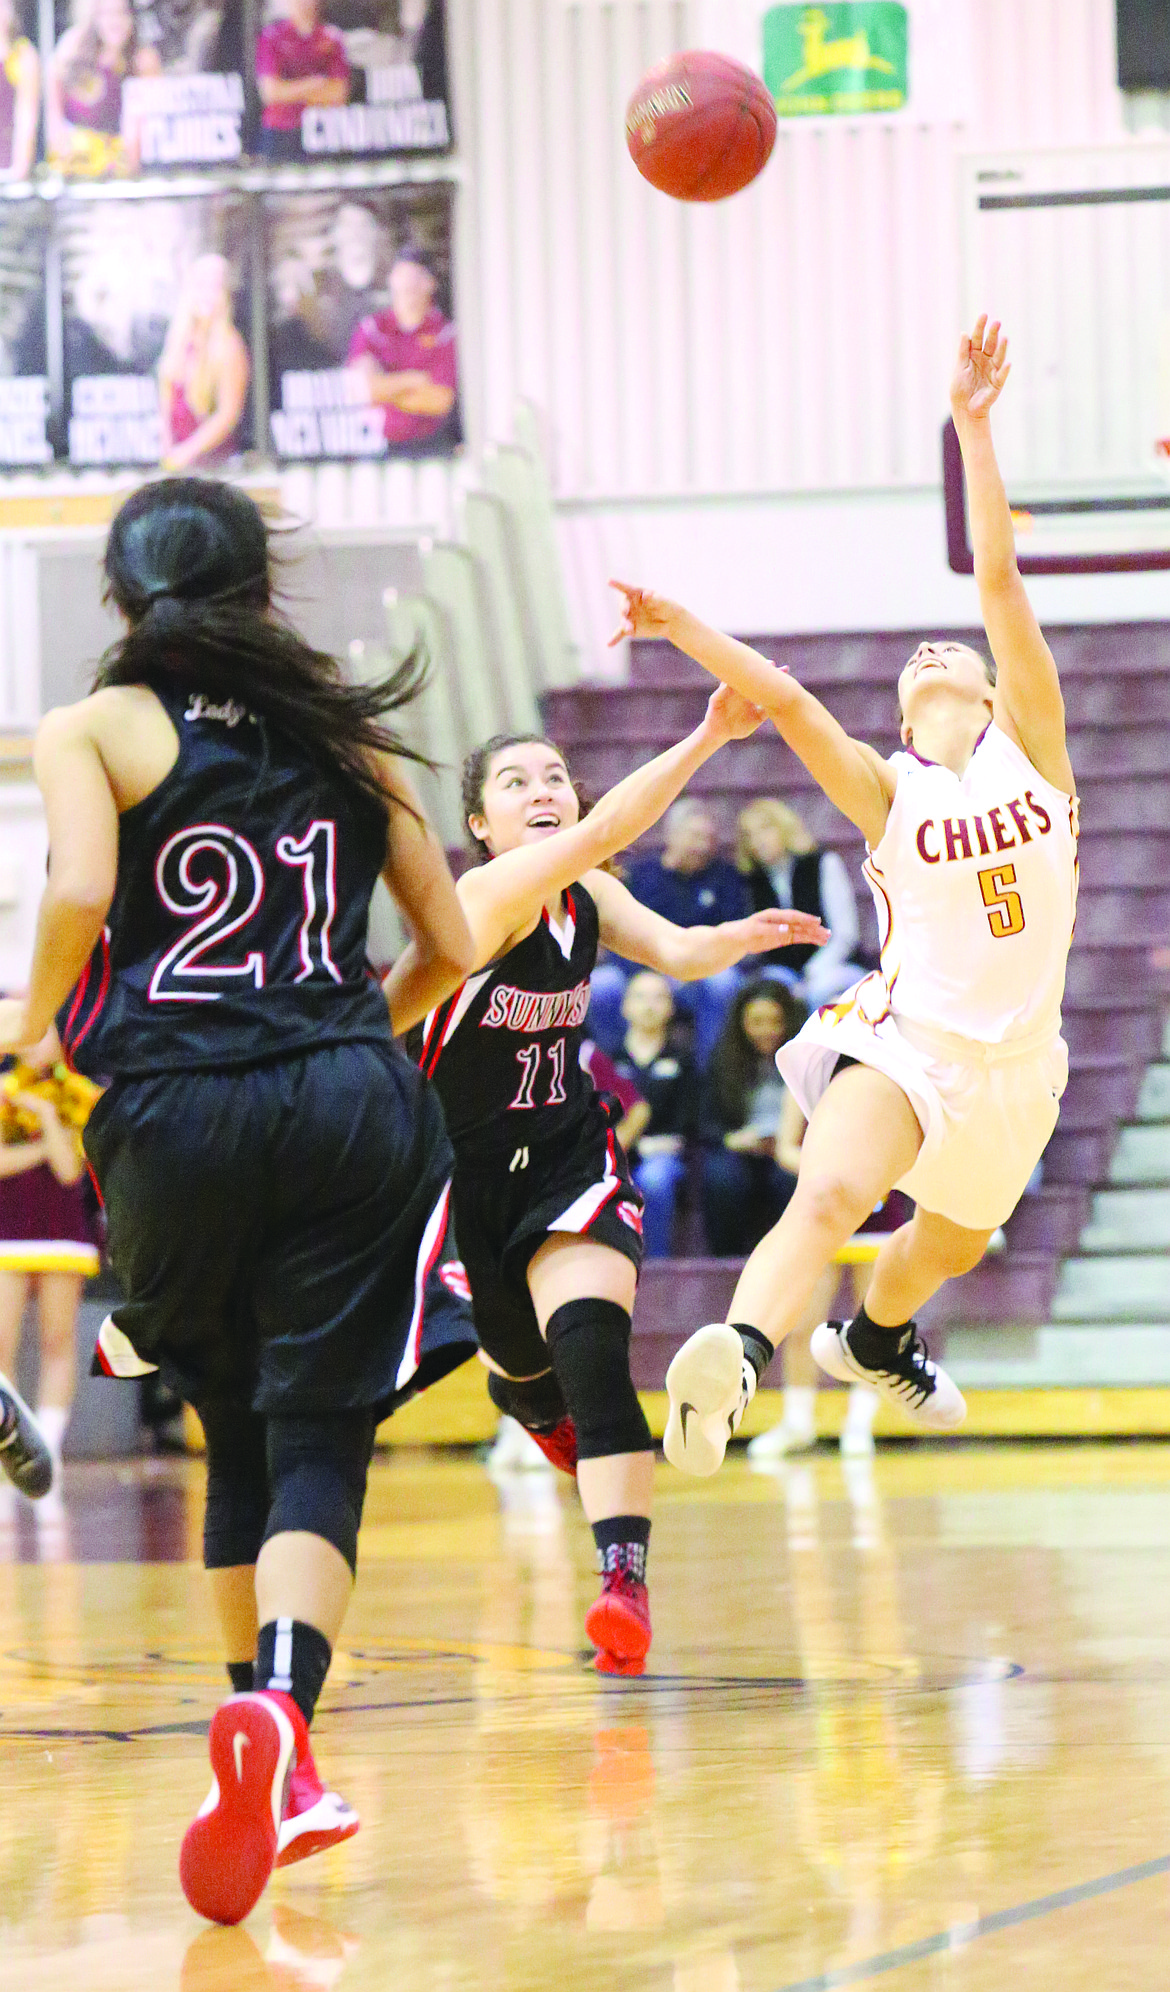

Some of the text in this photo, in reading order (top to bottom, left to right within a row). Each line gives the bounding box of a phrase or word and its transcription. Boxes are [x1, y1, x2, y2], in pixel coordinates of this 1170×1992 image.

[184, 693, 246, 728] Lady
[916, 790, 1052, 865] CHIEFS
[148, 819, 337, 1003] 21
[976, 863, 1026, 939] 5
[506, 1037, 567, 1110] 11
